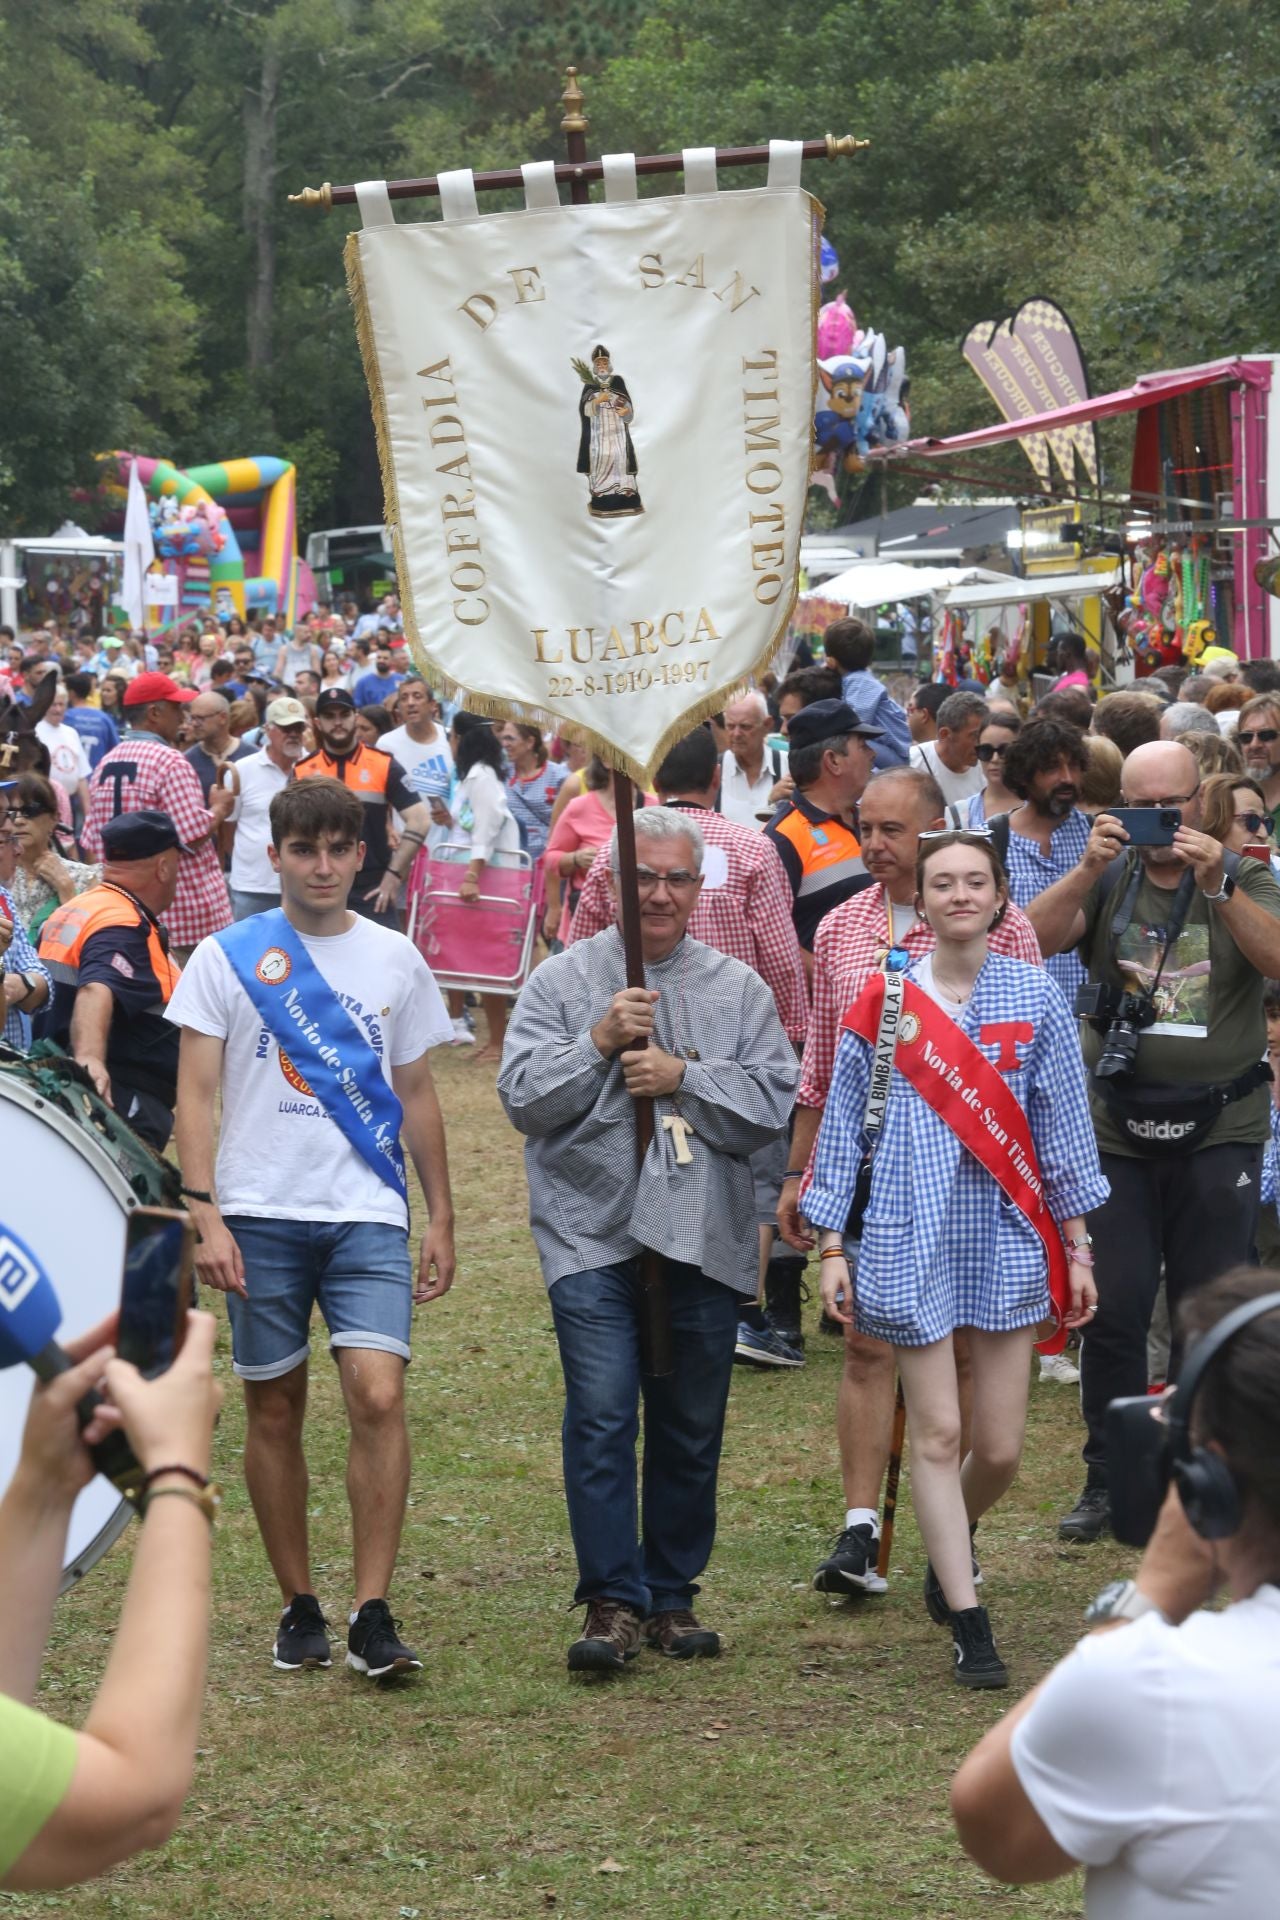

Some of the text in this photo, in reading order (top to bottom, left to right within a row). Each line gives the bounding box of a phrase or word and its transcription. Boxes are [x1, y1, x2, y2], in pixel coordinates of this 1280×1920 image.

[416, 251, 785, 626] COFRADIA DE SAN TIMOTEO
[530, 607, 723, 664] LUARCA
[548, 660, 711, 698] 22-8-1910-1997
[361, 1013, 384, 1063] ÁGUE
[881, 993, 901, 1035] LOLA
[280, 987, 321, 1045] Novio
[318, 1045, 341, 1070] de
[335, 1067, 373, 1125] Santa
[880, 1039, 894, 1050] Y
[871, 1052, 893, 1101] BIMBA
[919, 1039, 963, 1094] Novia
[961, 1086, 983, 1111] de
[978, 1105, 1008, 1147] San
[278, 1100, 320, 1118] LUARCA
[1126, 1118, 1197, 1141] adidas
